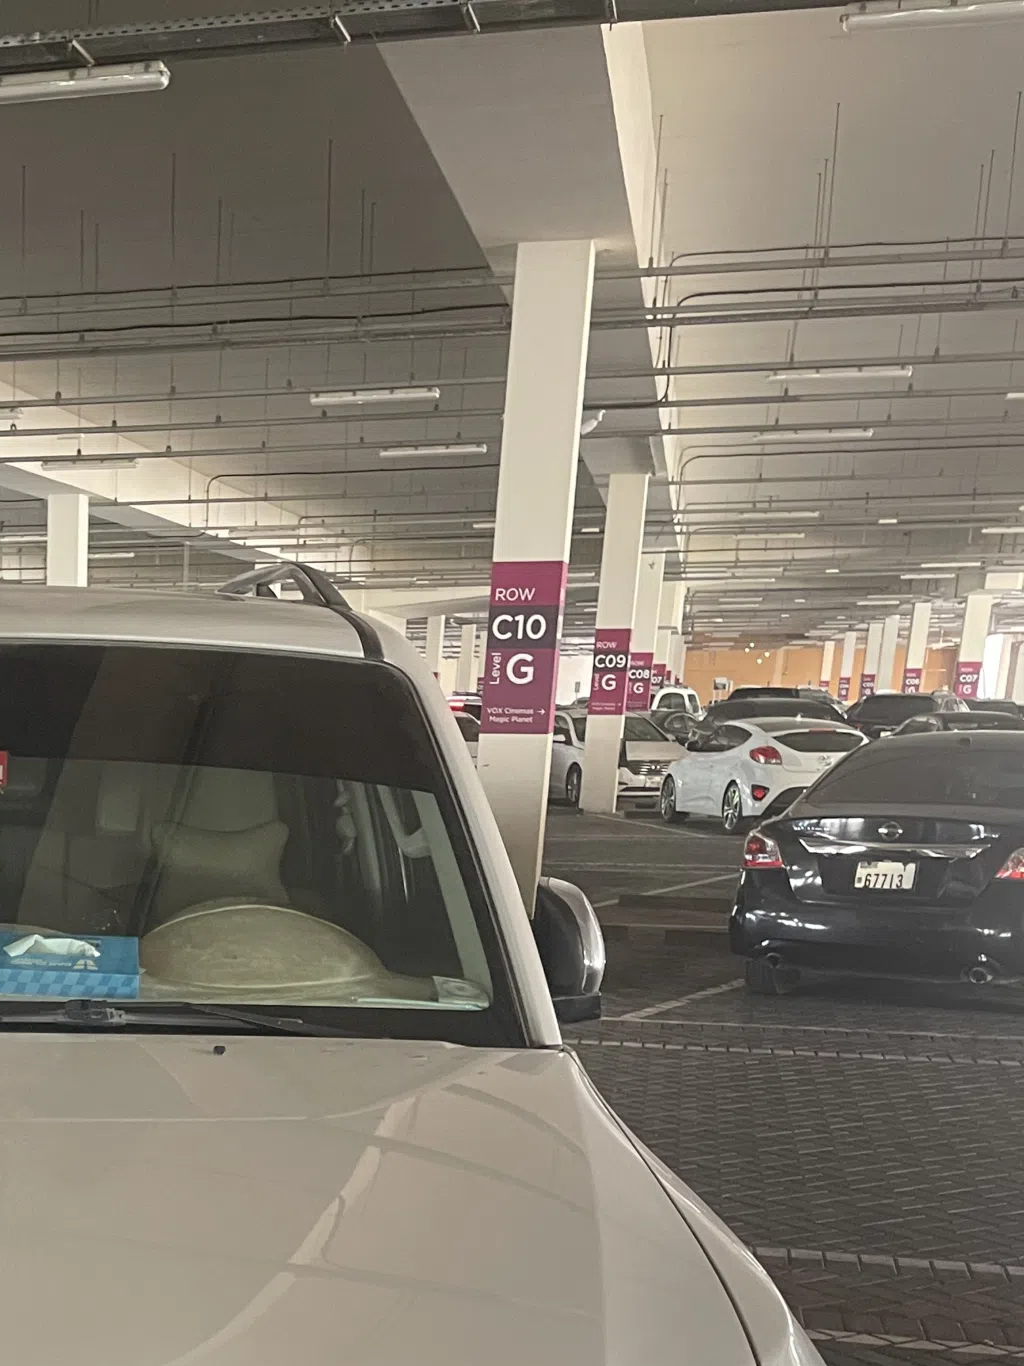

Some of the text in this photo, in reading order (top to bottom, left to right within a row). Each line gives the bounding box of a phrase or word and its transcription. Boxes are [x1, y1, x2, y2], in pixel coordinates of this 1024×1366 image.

[495, 587, 536, 601] ROW
[492, 614, 547, 640] C10
[596, 641, 617, 649] ROW
[595, 654, 626, 668] C09
[489, 652, 502, 685] Level
[506, 653, 534, 685] G
[628, 669, 650, 679] C08
[601, 673, 617, 691] G
[651, 676, 663, 684] 07
[959, 674, 979, 683] C07
[633, 682, 644, 694] G
[962, 684, 972, 695] G
[489, 715, 533, 723] Magic Planet
[864, 873, 904, 889] 67713
